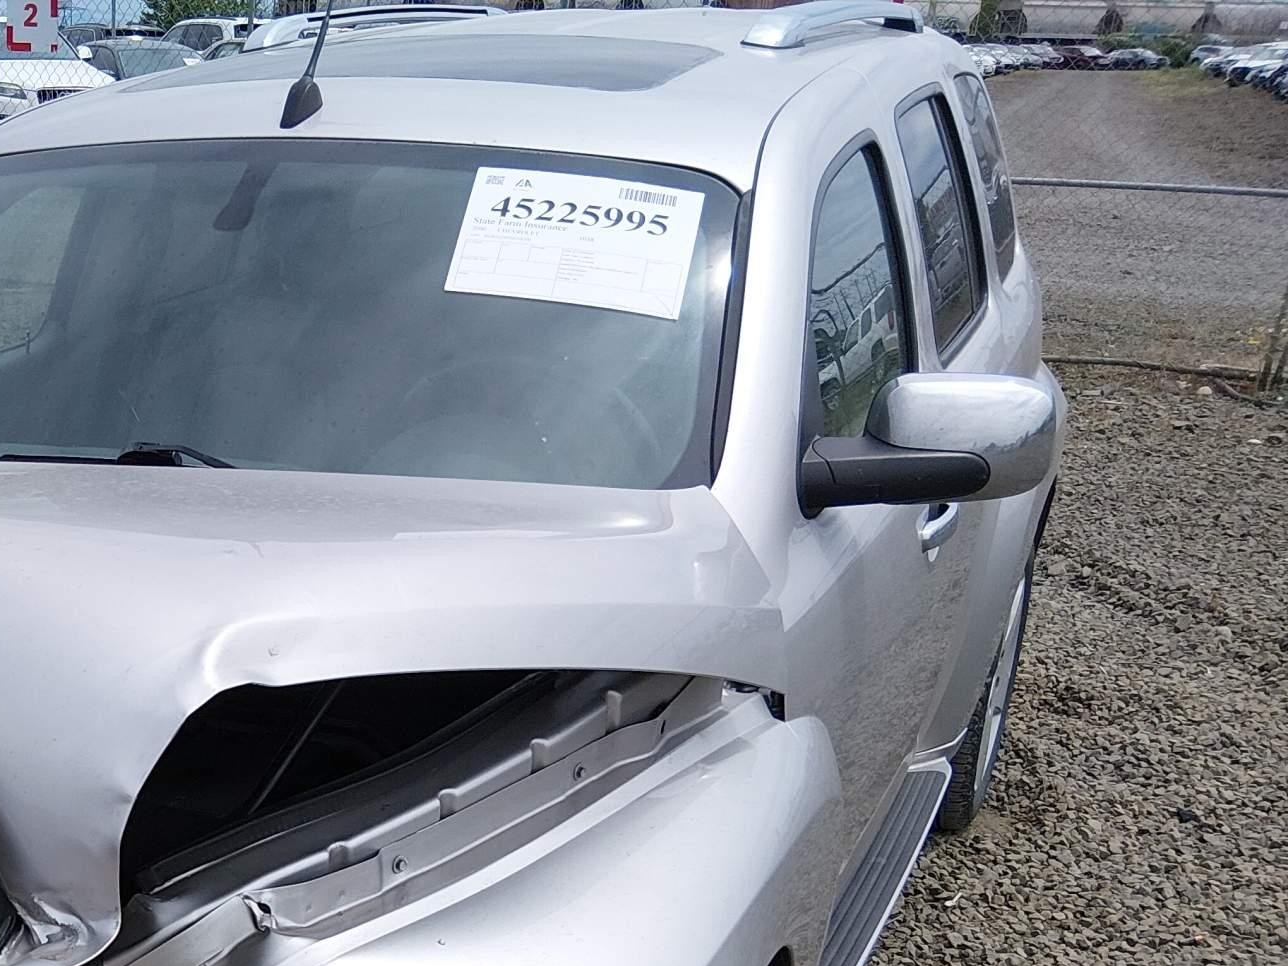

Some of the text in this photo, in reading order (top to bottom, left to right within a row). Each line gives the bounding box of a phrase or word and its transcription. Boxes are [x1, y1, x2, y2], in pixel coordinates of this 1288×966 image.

[24, 3, 38, 27] 2
[472, 217, 569, 232] State Farm Insurance
[490, 196, 669, 236] 45225995
